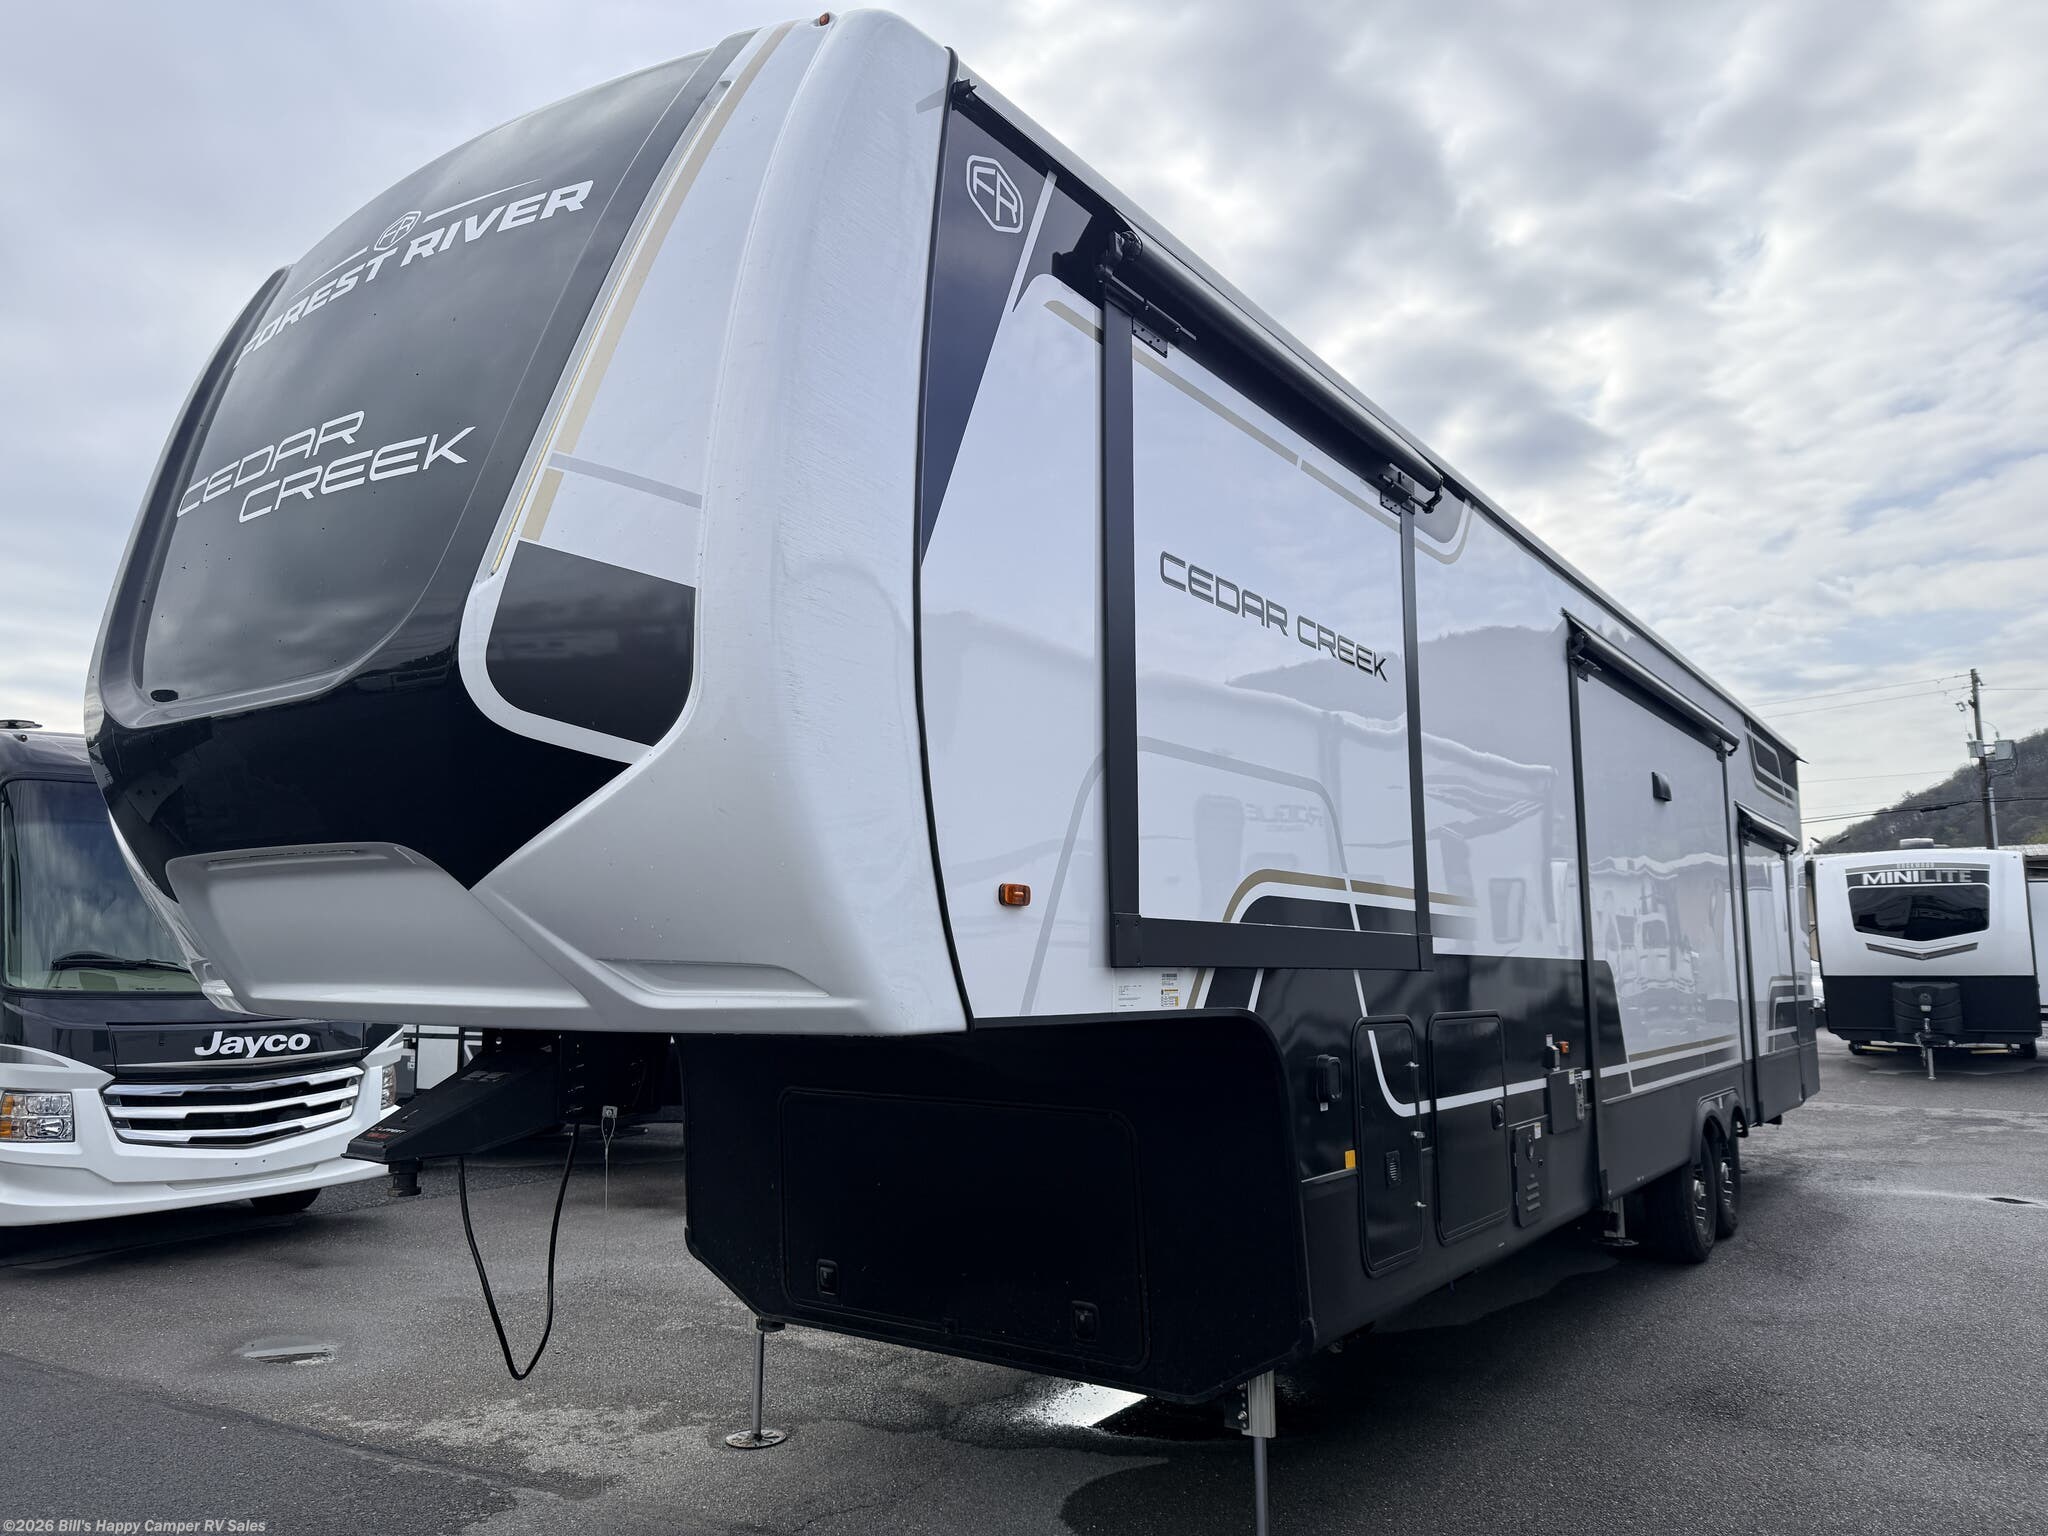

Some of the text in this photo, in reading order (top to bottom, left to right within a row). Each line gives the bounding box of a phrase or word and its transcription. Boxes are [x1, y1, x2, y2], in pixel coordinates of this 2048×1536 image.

[234, 179, 594, 369] FOREST RIVER
[176, 410, 365, 517] CEDAR
[238, 426, 476, 524] CREEK
[1160, 550, 1388, 682] CEDAR CREEK
[194, 1030, 311, 1058] Jayco
